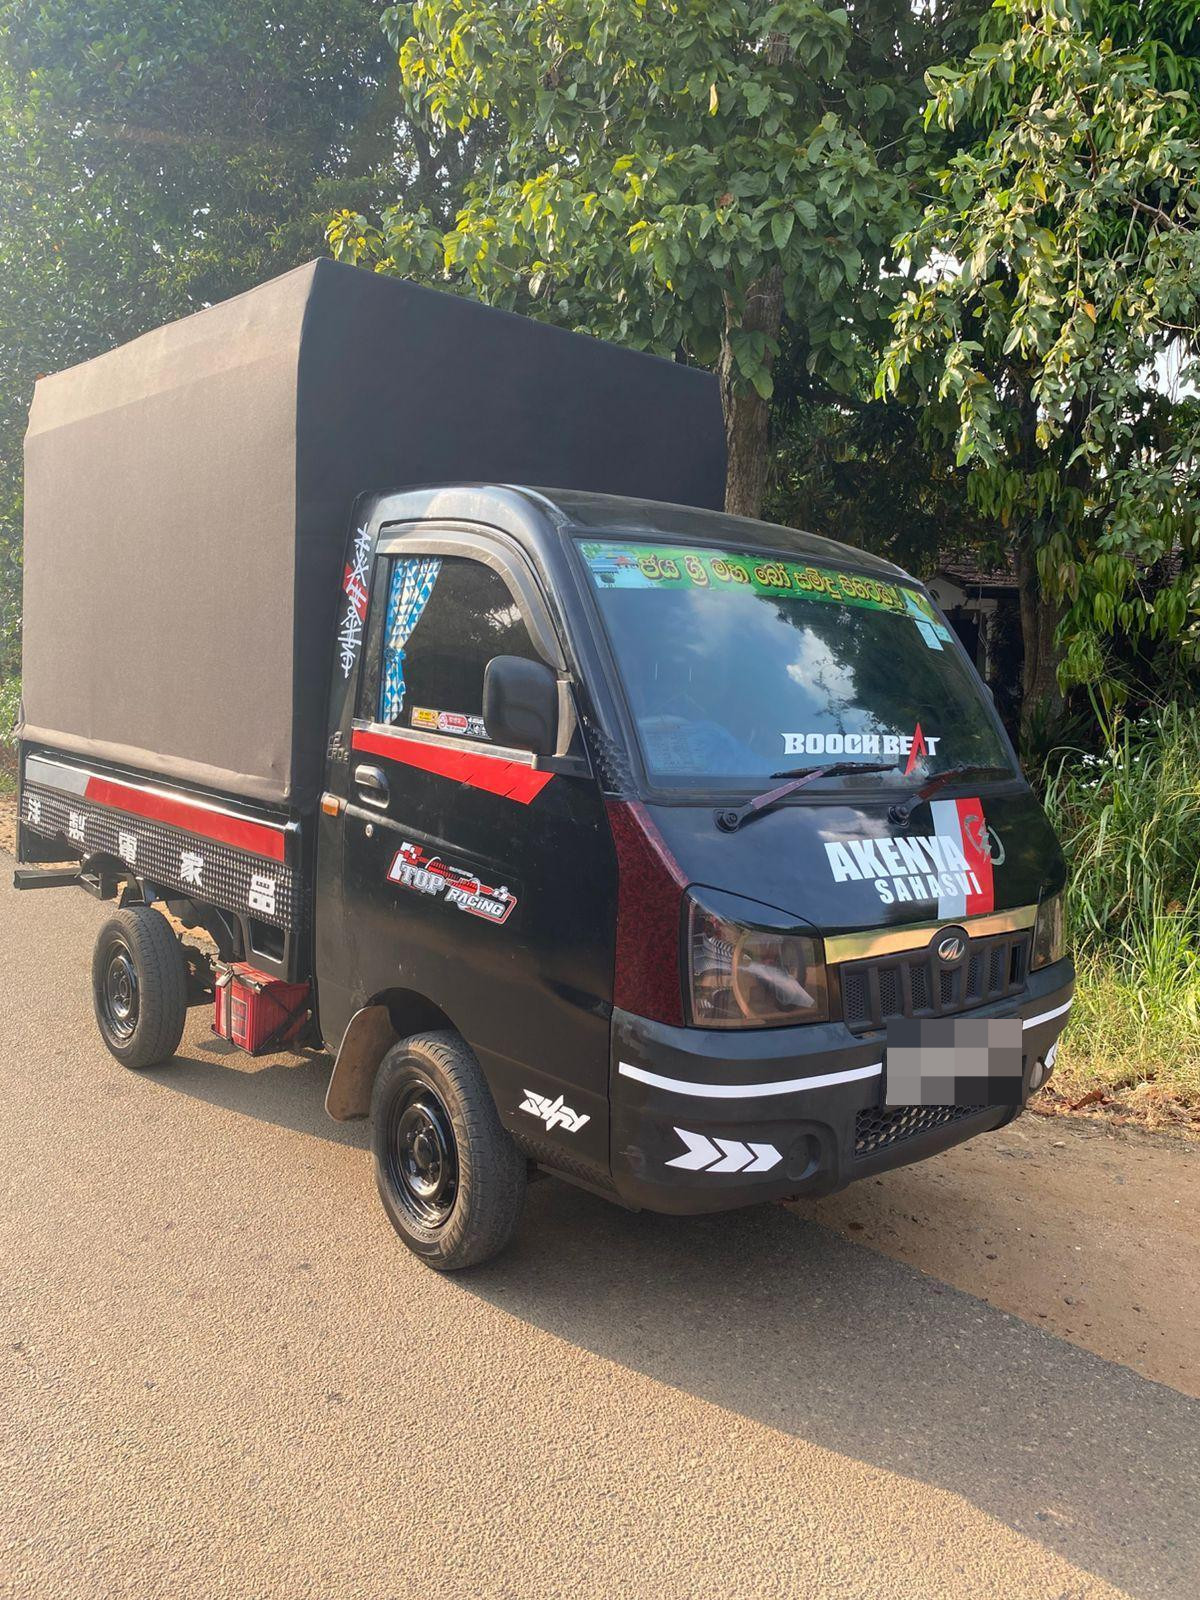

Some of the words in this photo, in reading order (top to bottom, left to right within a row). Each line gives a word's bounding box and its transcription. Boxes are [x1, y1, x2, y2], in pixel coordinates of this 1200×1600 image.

[638, 554, 681, 580] ජය
[709, 557, 751, 584] මහ
[754, 563, 792, 589] බෝ
[824, 836, 971, 882] AKENYA
[399, 862, 445, 896] TOP
[444, 887, 506, 918] RACING
[874, 872, 983, 904] SAHASVI
